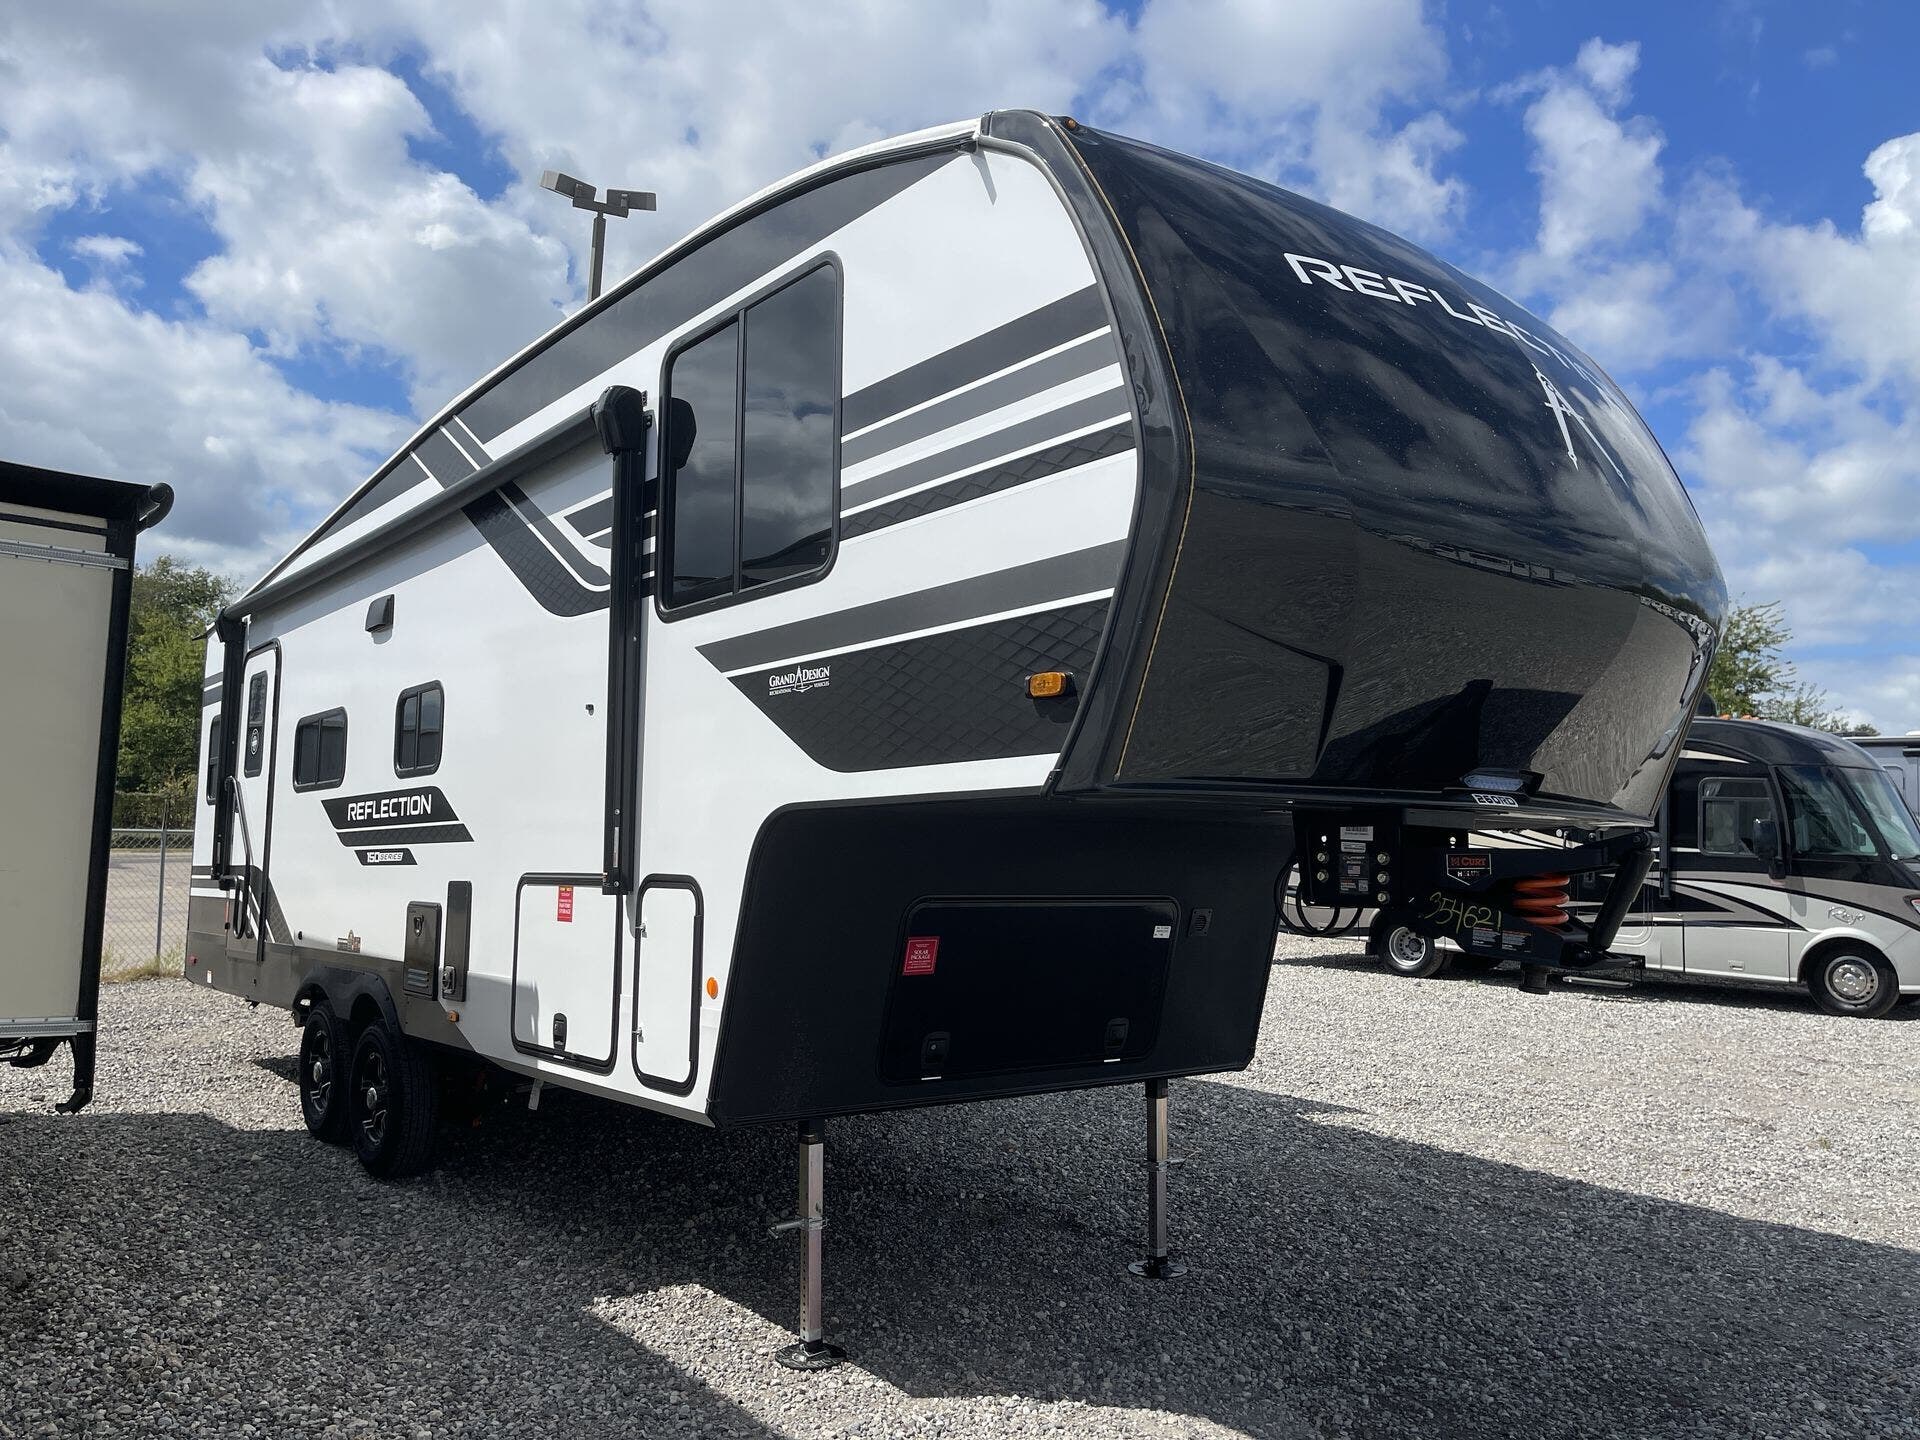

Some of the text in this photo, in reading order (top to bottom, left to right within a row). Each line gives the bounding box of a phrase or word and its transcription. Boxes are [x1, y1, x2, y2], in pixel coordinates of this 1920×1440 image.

[769, 666, 830, 687] GRAND DESIGN
[347, 793, 432, 821] REFLECTION
[380, 852, 403, 861] SERIES
[1424, 892, 1502, 934] 354621
